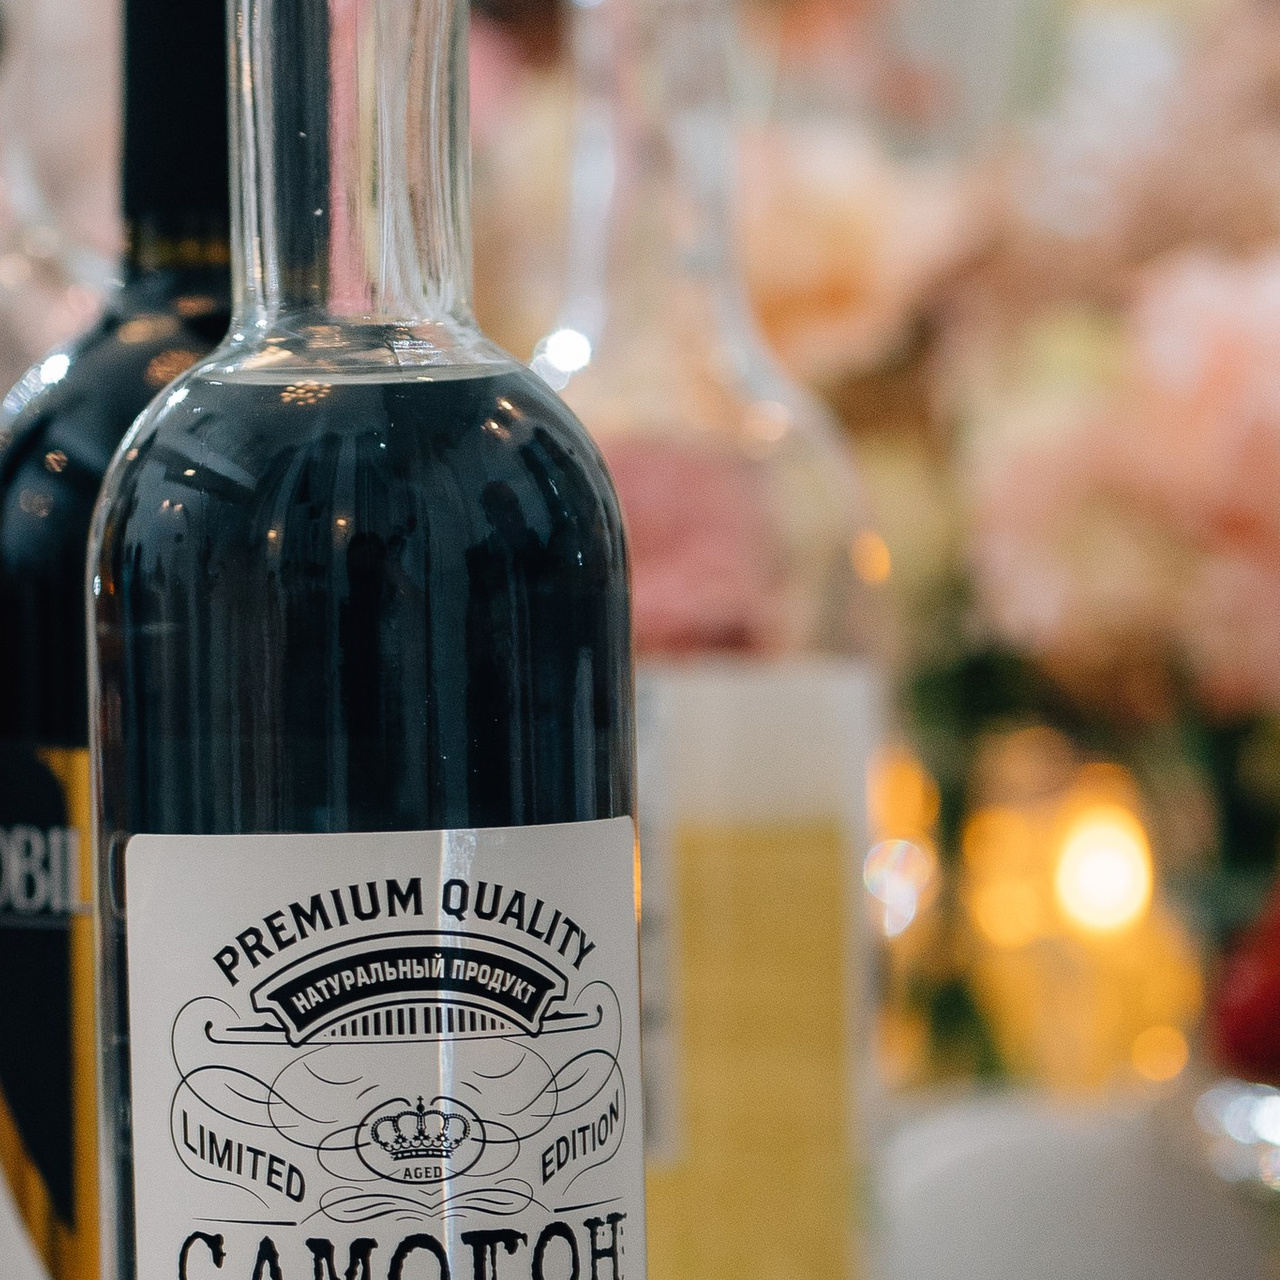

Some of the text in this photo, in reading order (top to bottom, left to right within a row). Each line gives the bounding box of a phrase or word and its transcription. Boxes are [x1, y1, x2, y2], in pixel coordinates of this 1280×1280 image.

[212, 876, 597, 988] PREMIUM QUALITY
[289, 952, 538, 1016] НАТУРАЛЬНЫЙ ПРОДУКТ
[181, 1088, 622, 1204] LIMITED EDITION
[402, 1165, 444, 1181] AGED
